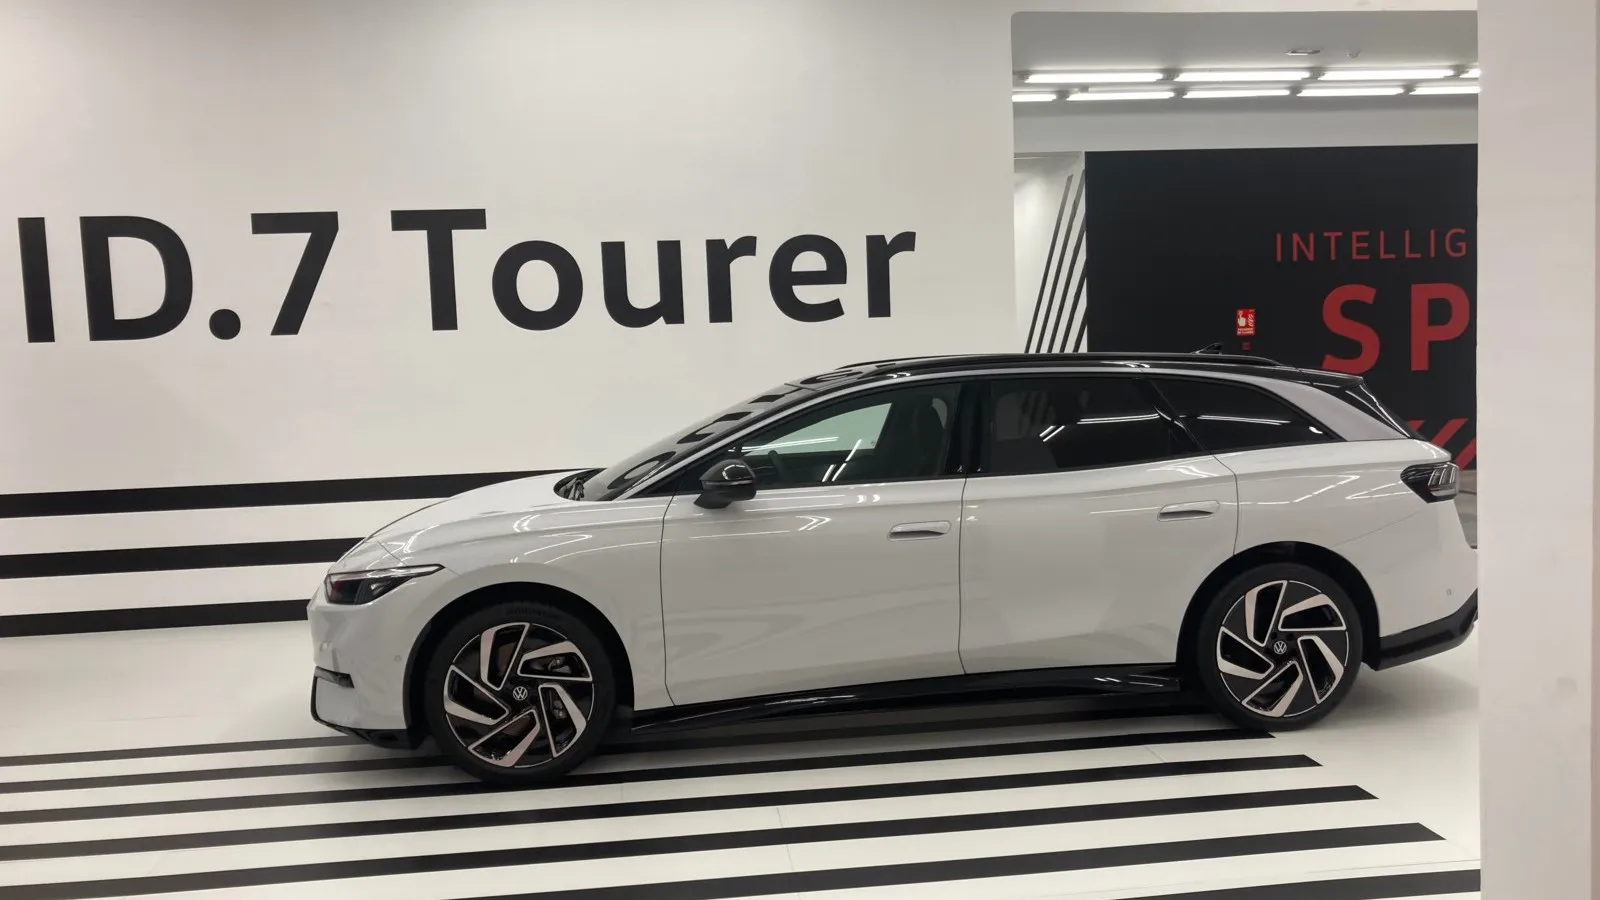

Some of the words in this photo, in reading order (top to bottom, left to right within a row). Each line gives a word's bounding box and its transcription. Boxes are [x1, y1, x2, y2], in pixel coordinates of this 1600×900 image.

[17, 211, 339, 343] ID.7
[390, 208, 917, 331] Tourer
[1275, 228, 1468, 262] INTELLIG
[1321, 282, 1471, 375] SP
